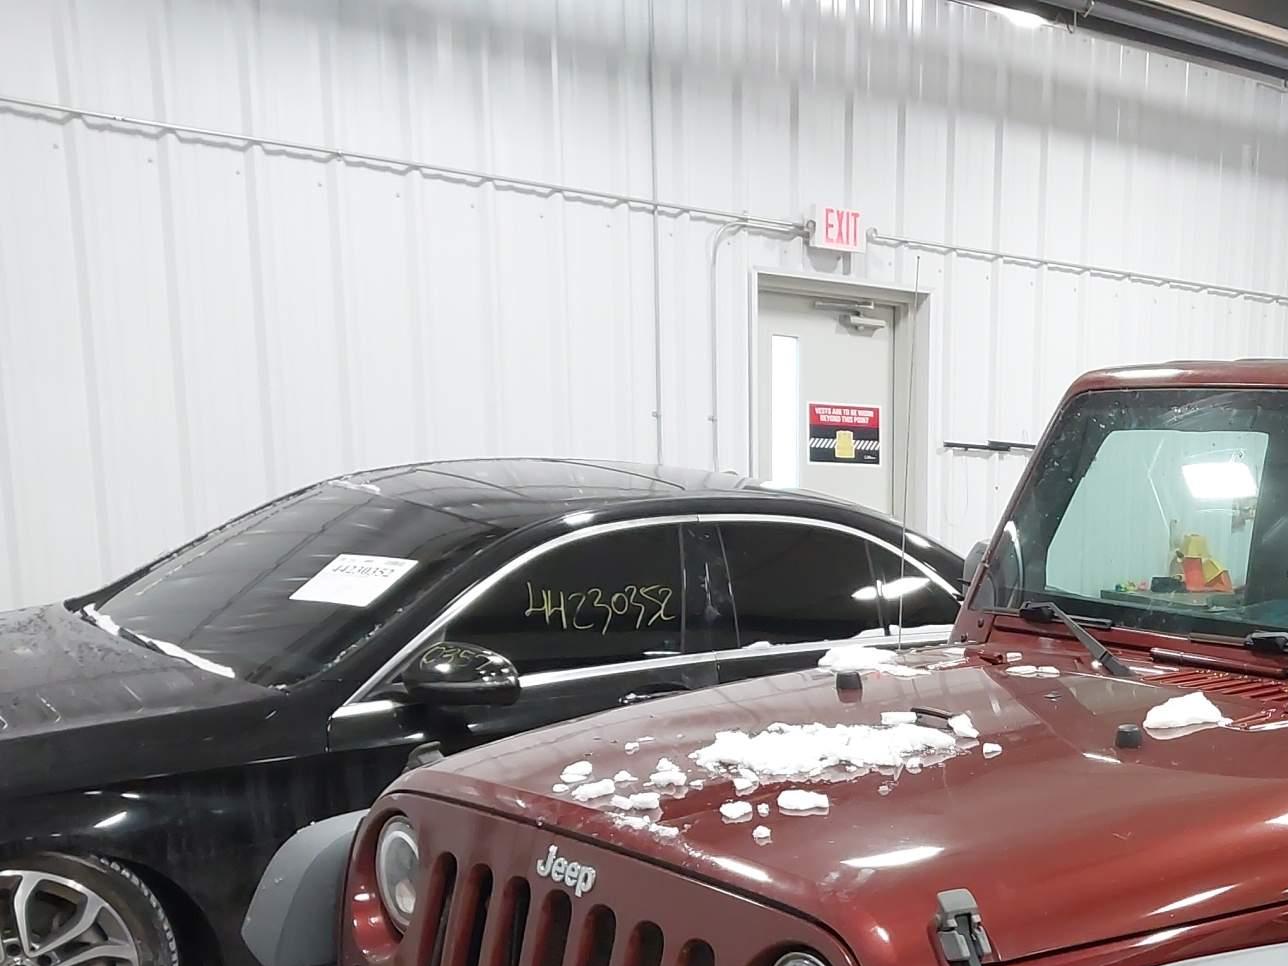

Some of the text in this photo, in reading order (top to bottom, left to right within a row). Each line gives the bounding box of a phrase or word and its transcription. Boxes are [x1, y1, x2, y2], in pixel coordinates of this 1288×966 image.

[824, 207, 861, 247] EXIT
[814, 407, 832, 415] VESTS
[331, 564, 396, 578] 44230352
[524, 582, 675, 636] 44230352
[537, 844, 596, 898] Jeep
